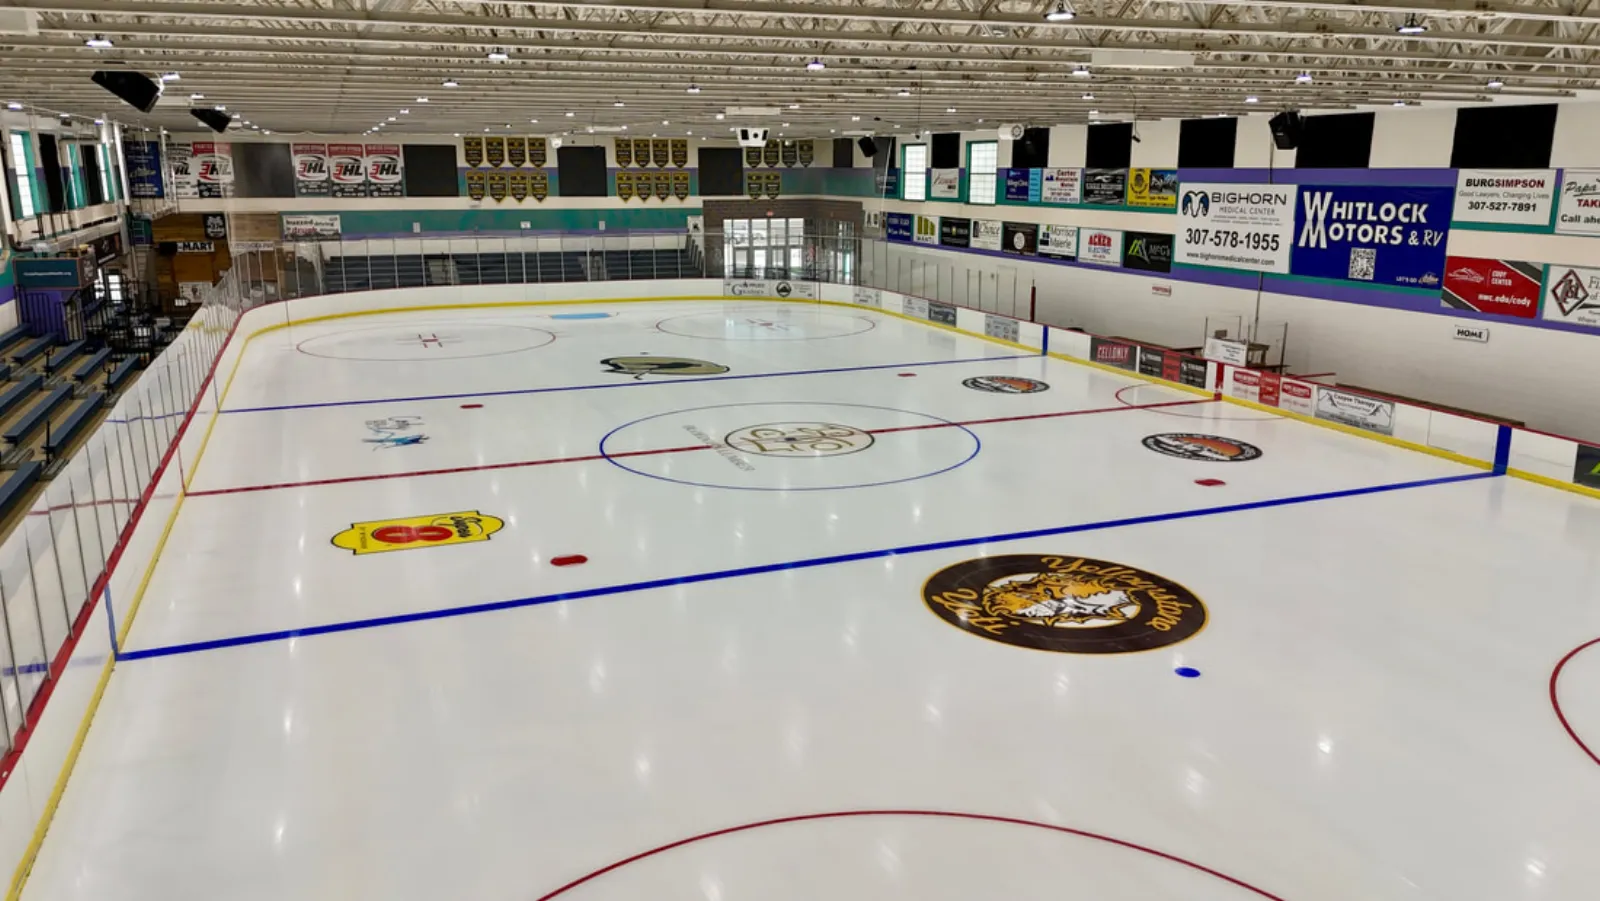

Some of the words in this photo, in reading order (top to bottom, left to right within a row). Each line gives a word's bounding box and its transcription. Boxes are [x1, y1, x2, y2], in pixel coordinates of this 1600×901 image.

[298, 162, 326, 175] 3HL
[333, 163, 363, 176] 3HL
[369, 163, 399, 175] 3HL
[1465, 178, 1545, 188] BURGSIMPSON
[1211, 191, 1287, 205] BIGHORN
[1219, 206, 1247, 215] MEDICAL
[1249, 207, 1275, 216] CENTER
[1303, 191, 1429, 223] WHITLOCK
[1467, 201, 1537, 212] 307-527-7891
[1560, 214, 1581, 223] Call
[1088, 233, 1112, 247] ACKER
[1185, 227, 1280, 251] 307-578-1955
[1298, 219, 1405, 249] MOTORS
[1407, 230, 1419, 246] &
[1422, 229, 1443, 247] RV
[1186, 252, 1275, 266] www.bighornmedicalcenter.com
[1491, 278, 1513, 286] CENTER
[1478, 293, 1532, 307] nwc.edu/cody
[1457, 328, 1483, 339] HOME
[1041, 556, 1192, 632] Yellowstone
[931, 587, 1020, 635] Yeti
